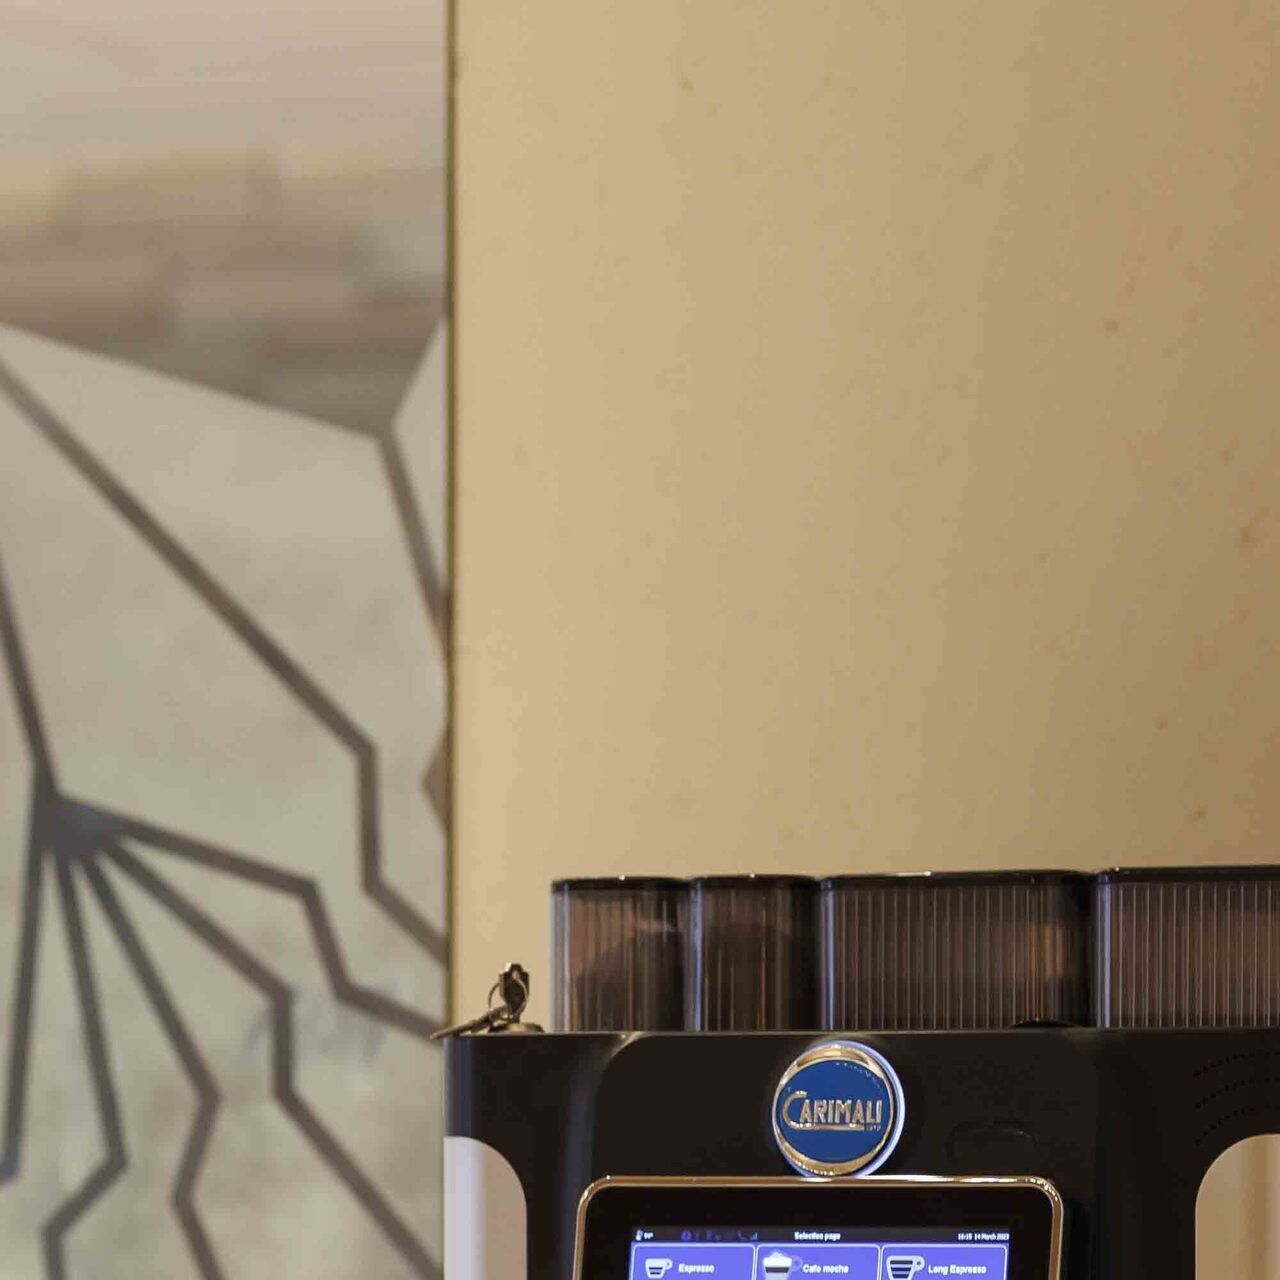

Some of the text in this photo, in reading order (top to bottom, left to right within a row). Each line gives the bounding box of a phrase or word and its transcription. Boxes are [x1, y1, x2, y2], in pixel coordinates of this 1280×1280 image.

[782, 1090, 883, 1131] CARIMALI
[678, 1263, 715, 1274] Espresso
[928, 1265, 987, 1275] Long Espresso
